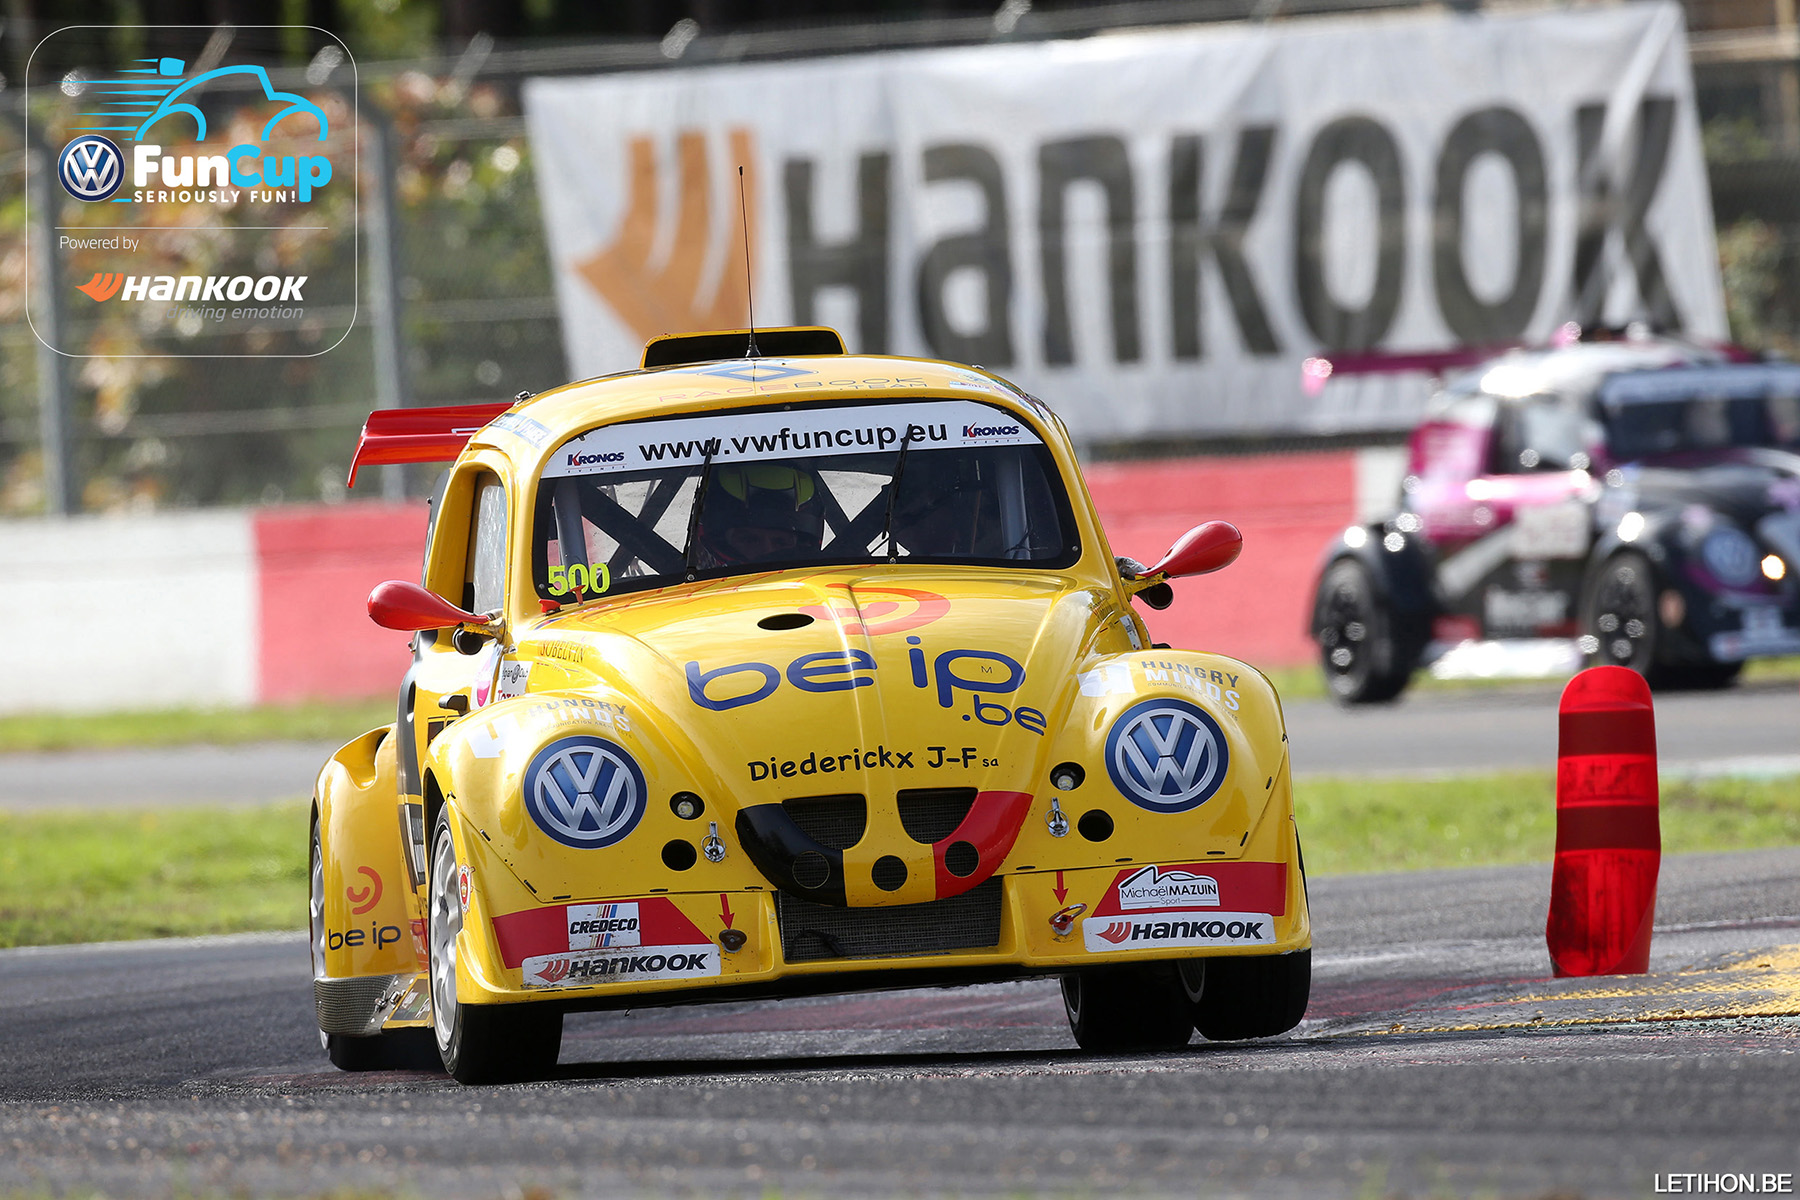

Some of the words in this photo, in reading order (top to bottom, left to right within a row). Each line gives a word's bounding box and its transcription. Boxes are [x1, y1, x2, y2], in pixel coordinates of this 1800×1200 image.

[567, 450, 625, 467] KRONOS
[639, 422, 948, 462] www.vwfuncup.eu
[962, 422, 1020, 438] KRONOS
[547, 562, 611, 597] 500
[684, 647, 878, 711] be
[905, 635, 1027, 708] ip
[1141, 660, 1240, 689] HUNGRY
[1144, 668, 1241, 712] MINDS
[747, 745, 915, 783] Diederickx
[927, 745, 978, 770] J-F
[981, 757, 999, 768] sa
[1160, 897, 1181, 906] Sport
[328, 928, 366, 951] be
[372, 921, 401, 951] ip
[569, 917, 638, 935] CREDECO
